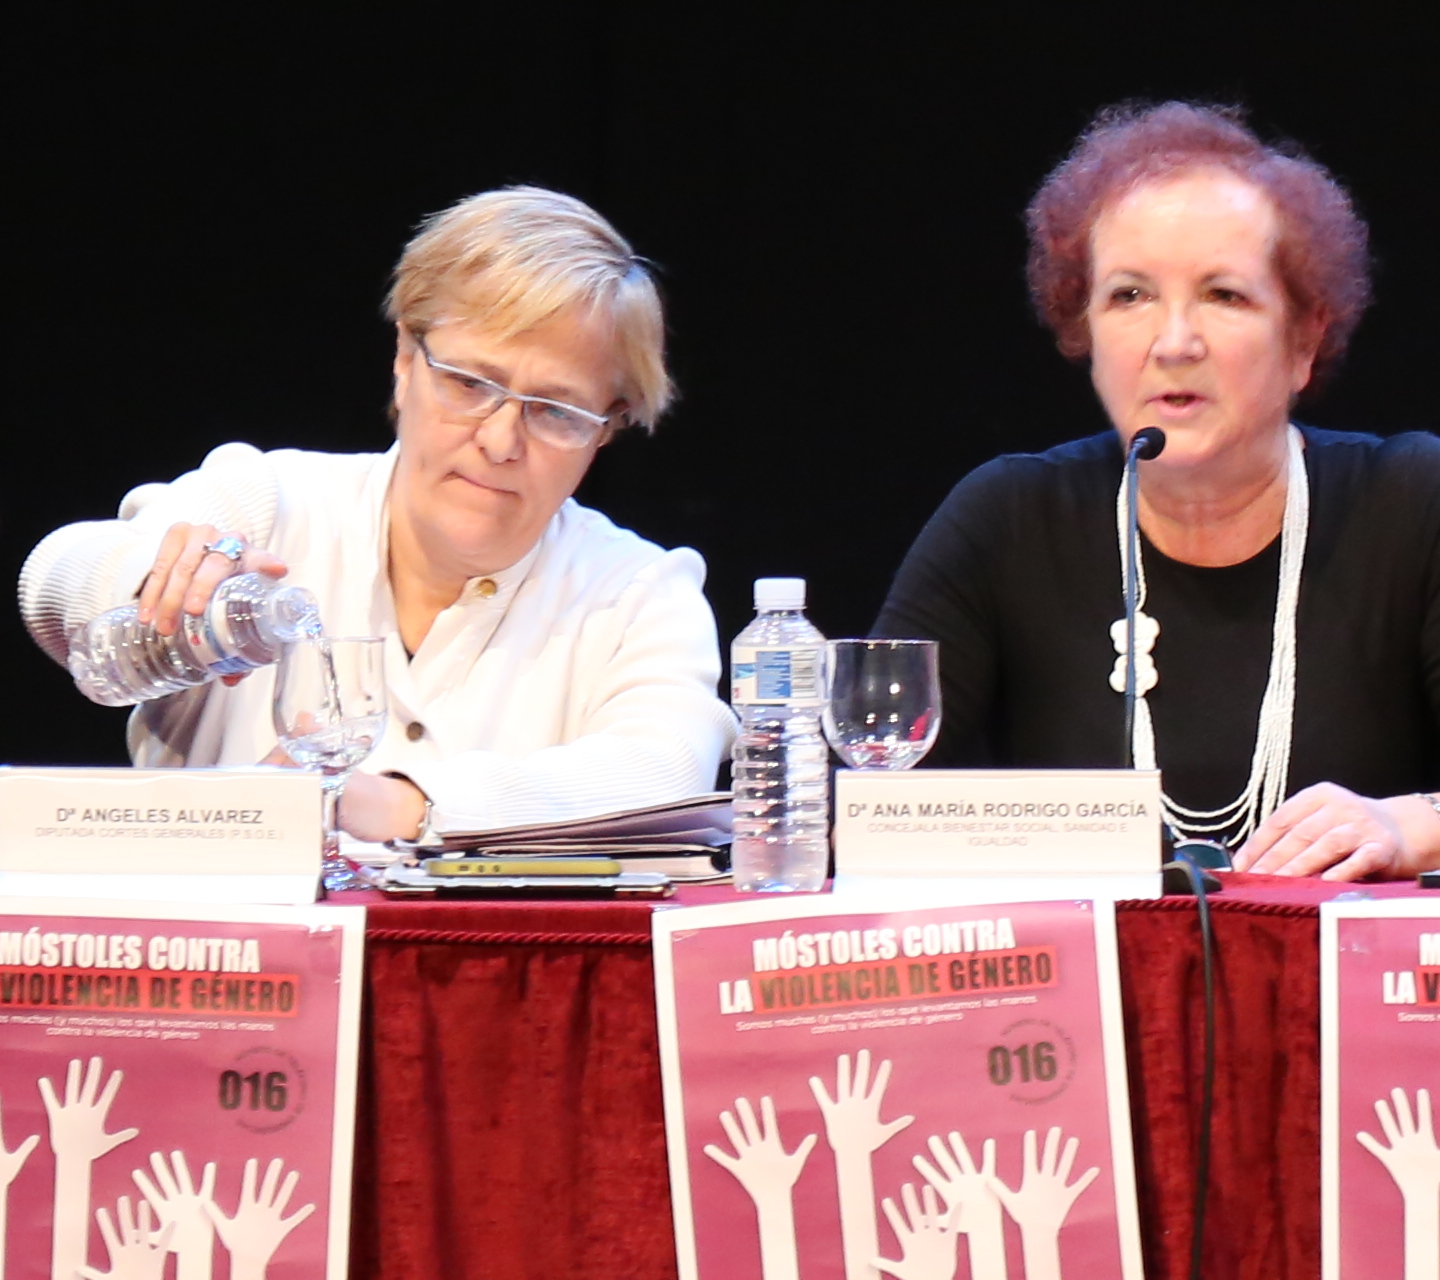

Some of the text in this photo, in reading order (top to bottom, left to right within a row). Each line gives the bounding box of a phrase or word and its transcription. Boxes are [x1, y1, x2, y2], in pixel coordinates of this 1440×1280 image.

[81, 808, 170, 823] ANGELES
[176, 809, 263, 824] ALVAREZ
[872, 803, 910, 818] ANA
[918, 800, 977, 818] MARÍA
[983, 803, 1070, 818] RODRIGO
[1076, 800, 1148, 818] GARCÍA
[148, 936, 261, 972] CONTRA
[752, 918, 1016, 972] MÓSTOLES CONTRA
[149, 976, 181, 1008] DE
[190, 972, 294, 1012] GÉNERO
[719, 952, 1053, 1014] LA VIOLENCIA DE GÉNERO
[1382, 971, 1417, 1004] LA
[987, 1041, 1057, 1086] 016
[218, 1069, 287, 1111] 016
